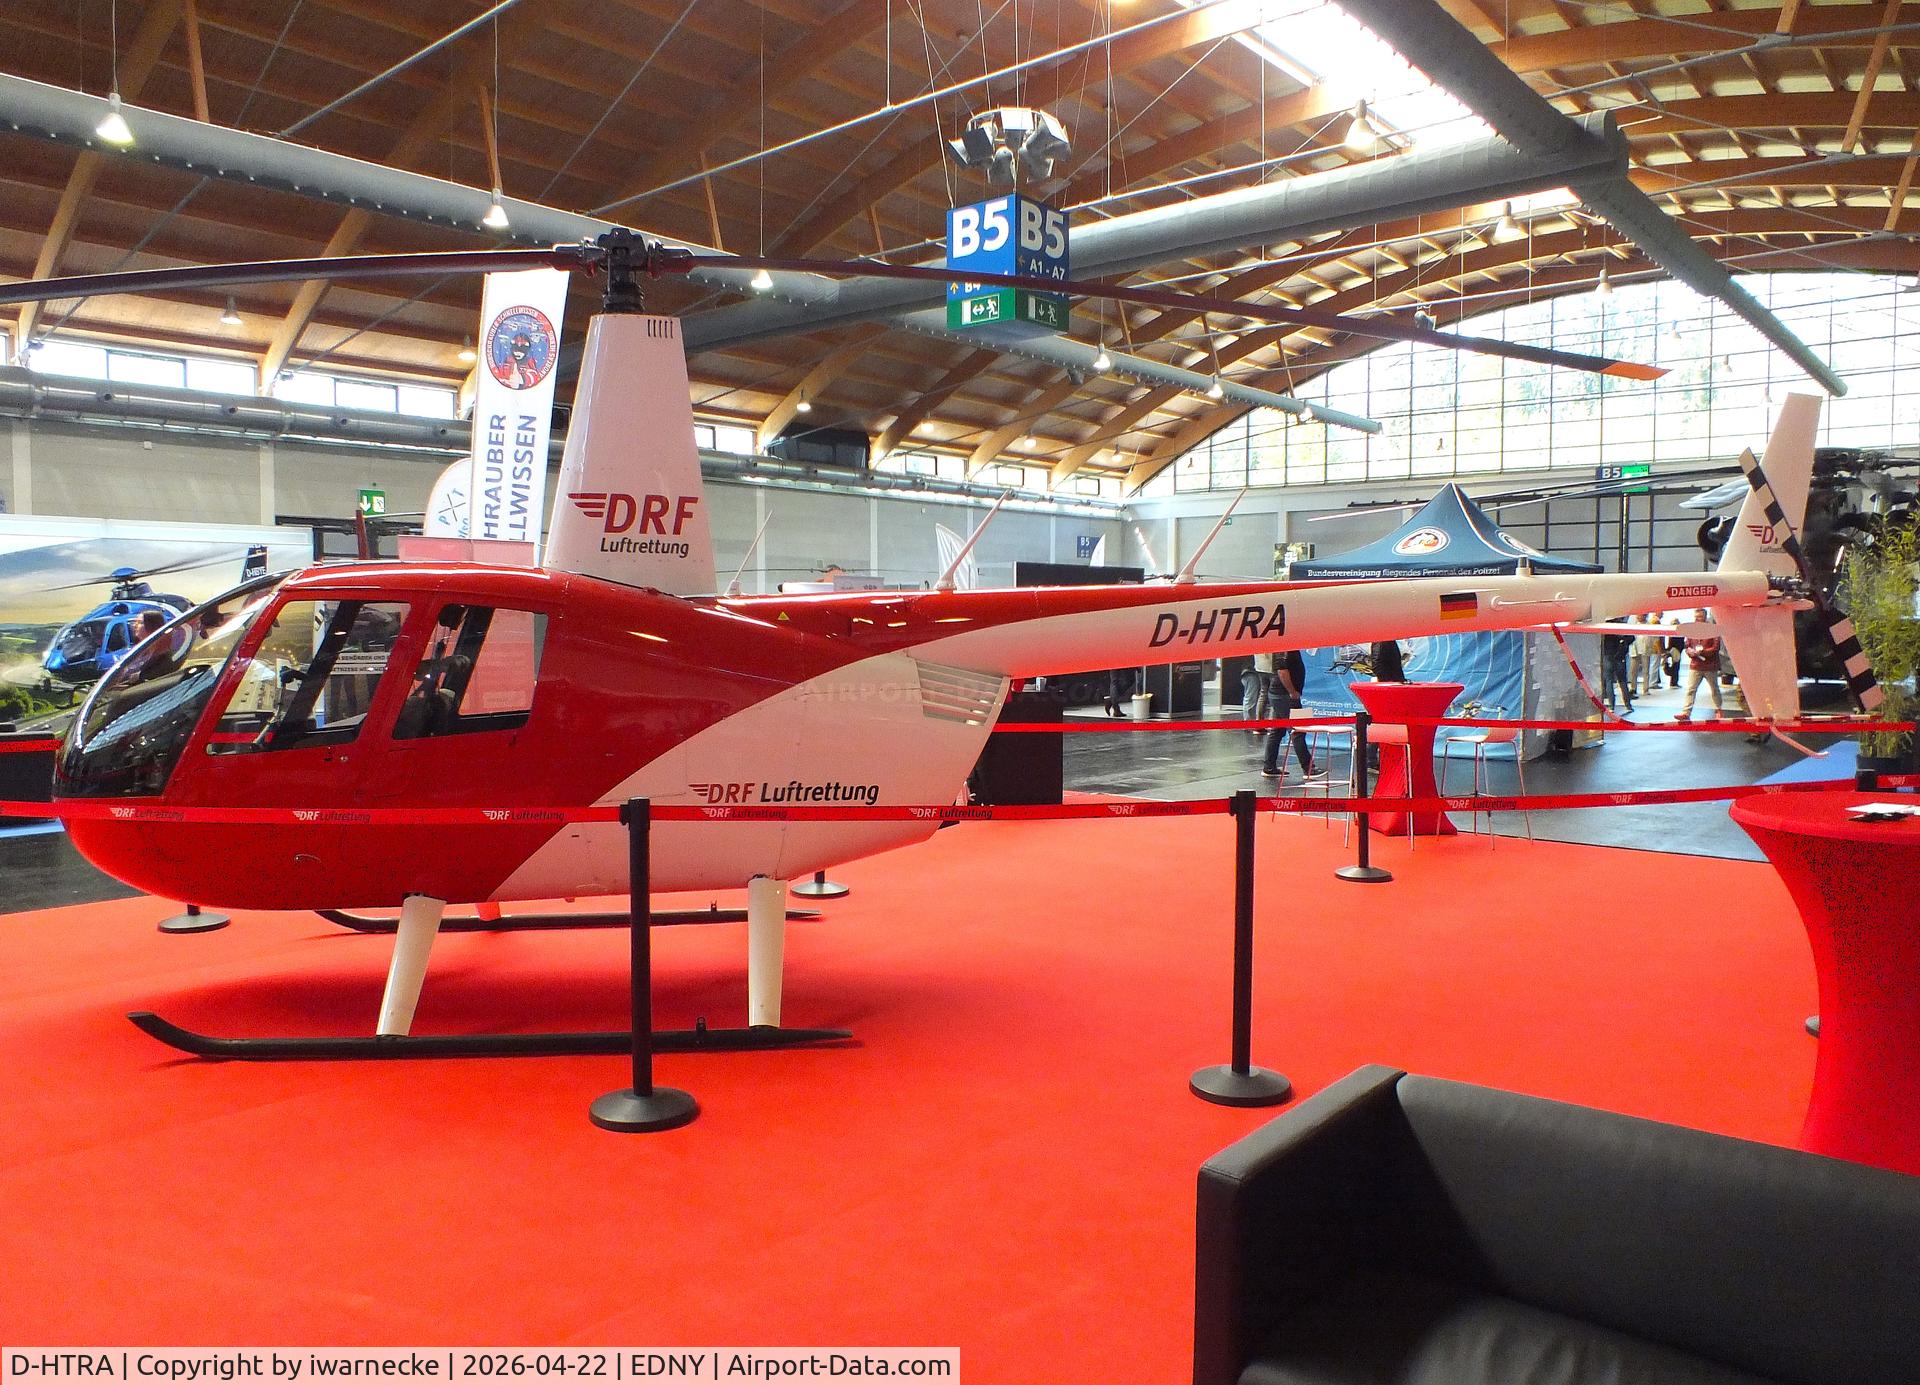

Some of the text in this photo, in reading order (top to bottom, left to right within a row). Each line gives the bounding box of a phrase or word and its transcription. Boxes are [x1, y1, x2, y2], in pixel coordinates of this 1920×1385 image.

[952, 199, 1009, 258] B5
[1020, 200, 1065, 259] B5
[1030, 258, 1043, 274] A1
[1052, 266, 1065, 280] A7
[483, 414, 507, 539] HRAUBER
[1601, 467, 1620, 479] B5
[602, 493, 699, 535] DRF
[1080, 537, 1090, 546] B5
[600, 537, 689, 558] Luftrettung
[1307, 569, 1381, 578] Bundesvereinigung
[1382, 568, 1421, 577] fliegendes
[1473, 567, 1501, 575] Polizei
[1671, 586, 1714, 597] DANGER
[1148, 603, 1286, 648] D-HTRA
[1300, 698, 1343, 708] Gemeinsam
[1313, 708, 1343, 717] Zukunft
[706, 781, 880, 805] DRF Luftrettung
[1276, 800, 1296, 809] DRF
[1452, 800, 1470, 809] DRF
[1615, 794, 1632, 804] DRF
[114, 808, 136, 818] DRF
[708, 807, 731, 818] DRF
[916, 807, 993, 819] DRF Luftrettung
[1115, 804, 1135, 815] DRF
[299, 811, 320, 821] DRF
[489, 810, 565, 822] DRF Luftrettung
